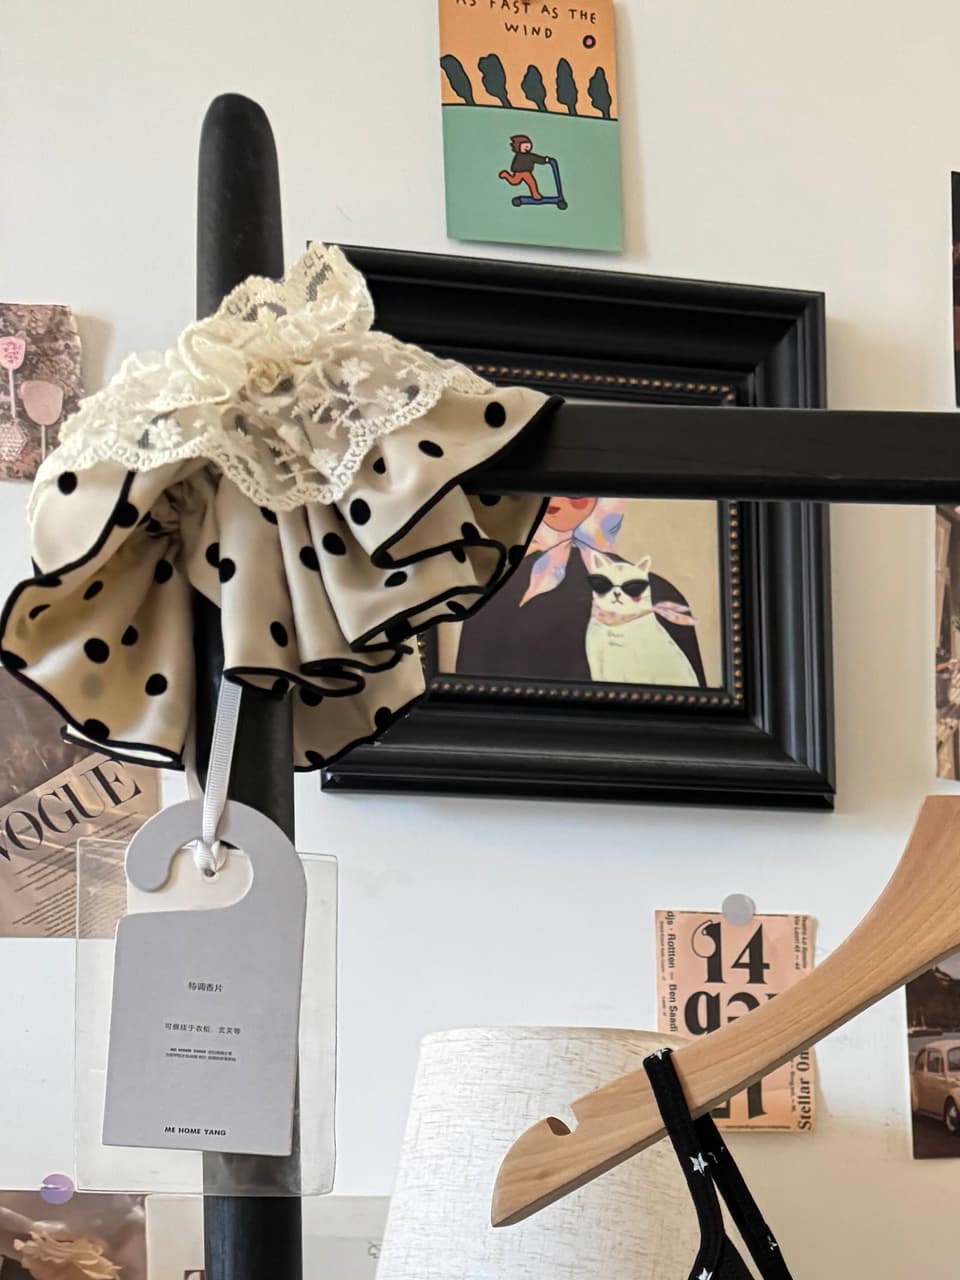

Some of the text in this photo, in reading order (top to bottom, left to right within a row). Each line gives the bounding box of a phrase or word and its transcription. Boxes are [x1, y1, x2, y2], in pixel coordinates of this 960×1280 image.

[489, 0, 531, 15] FAST
[541, 4, 559, 19] AS
[568, 9, 597, 25] THE
[504, 22, 553, 39] WIND
[0, 760, 142, 861] OGUE
[691, 919, 771, 985] 14
[797, 1077, 812, 1131] Stellar
[164, 1126, 176, 1134] ME
[178, 1127, 201, 1135] HOME
